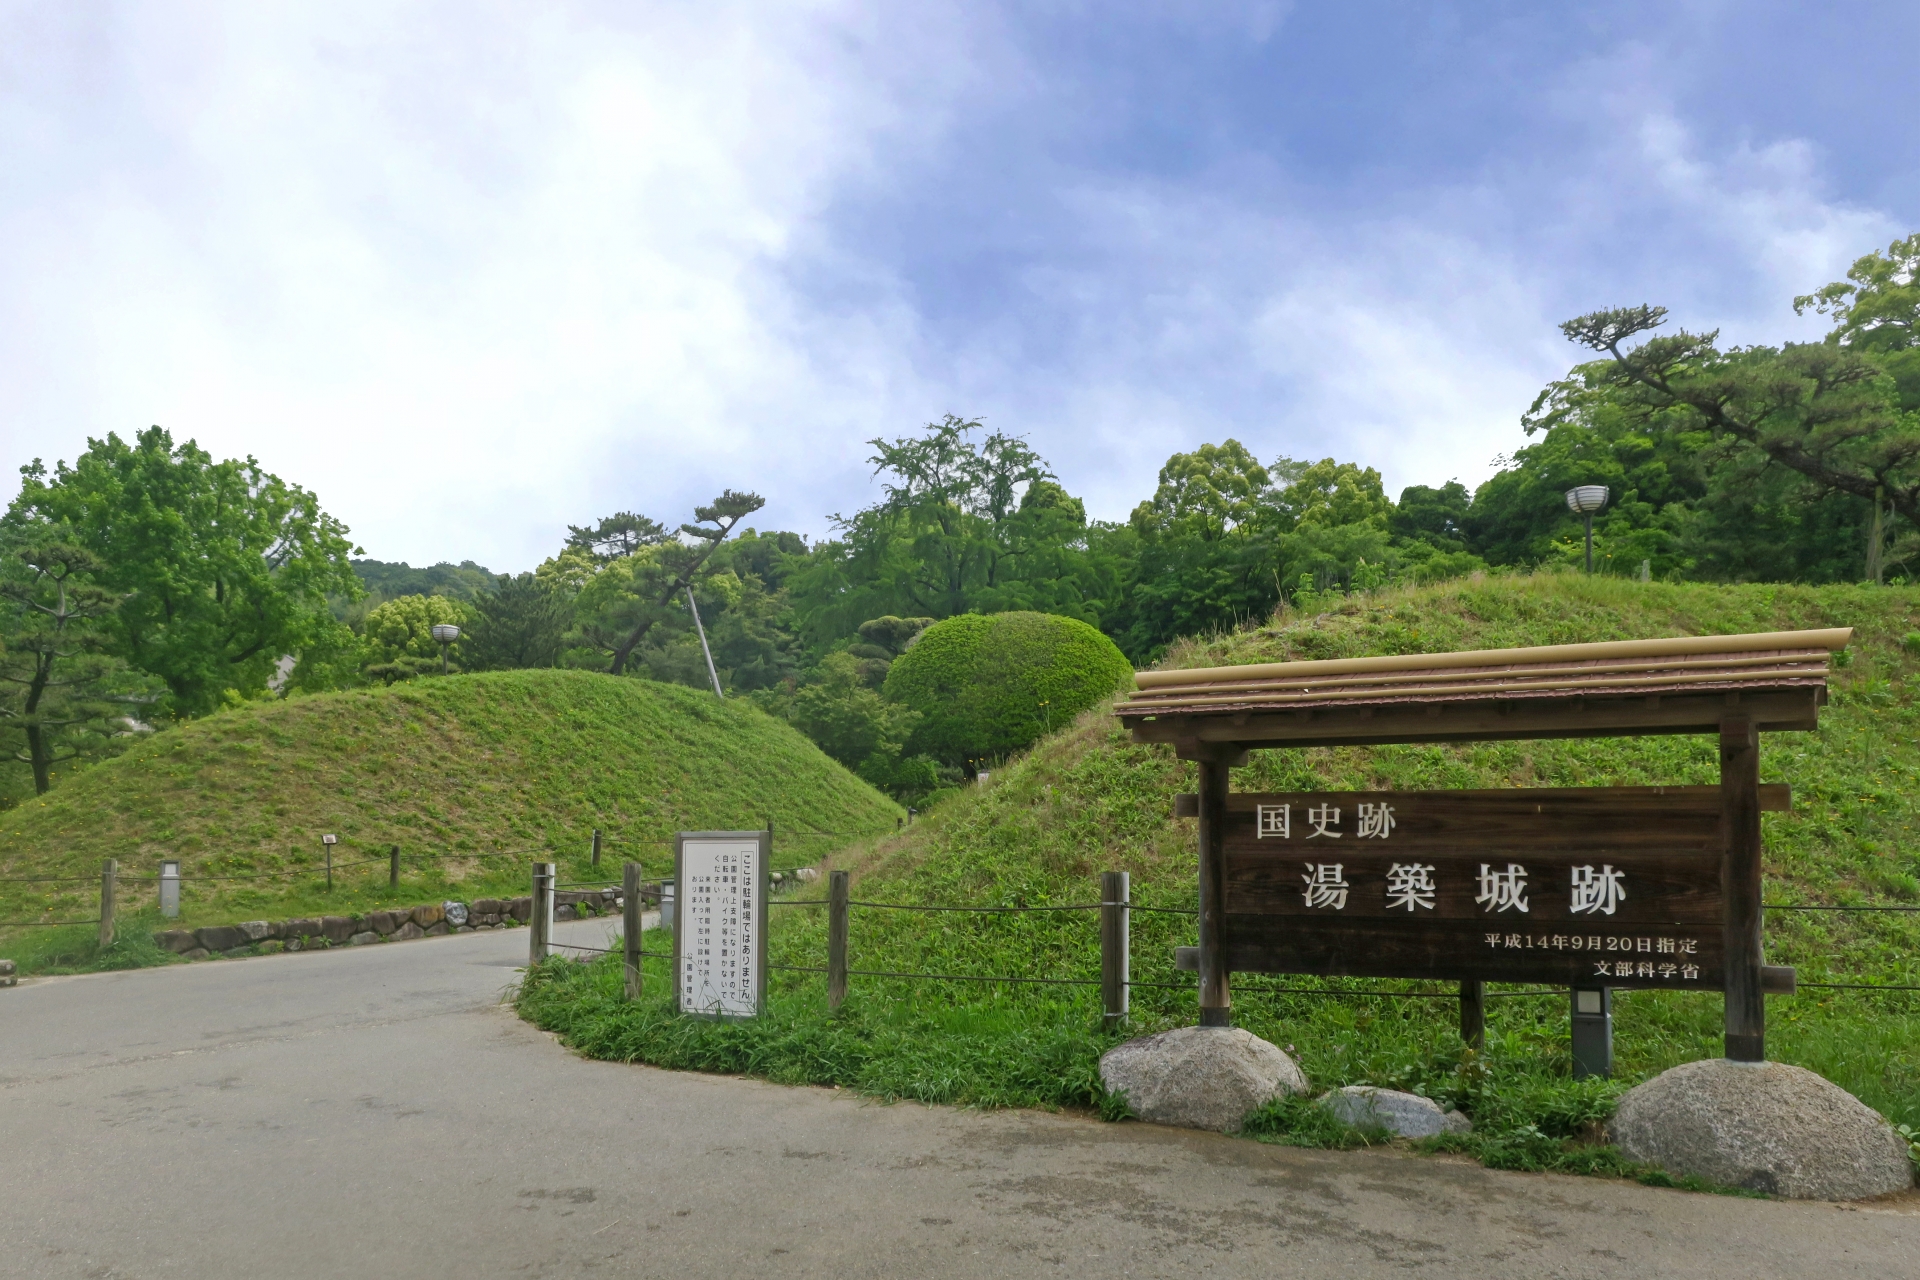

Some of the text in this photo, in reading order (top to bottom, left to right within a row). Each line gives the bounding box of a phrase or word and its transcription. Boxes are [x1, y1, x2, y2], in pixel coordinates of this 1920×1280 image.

[1257, 803, 1396, 839] 国史跡
[1301, 863, 1626, 915] 湯築城跡
[729, 855, 737, 999] 公園管理上支障になりますので
[741, 855, 751, 999] ここは駐輪場ではありません
[1485, 933, 1698, 953] 平成14年9月20日指定
[1593, 961, 1699, 979] 文部科学省
